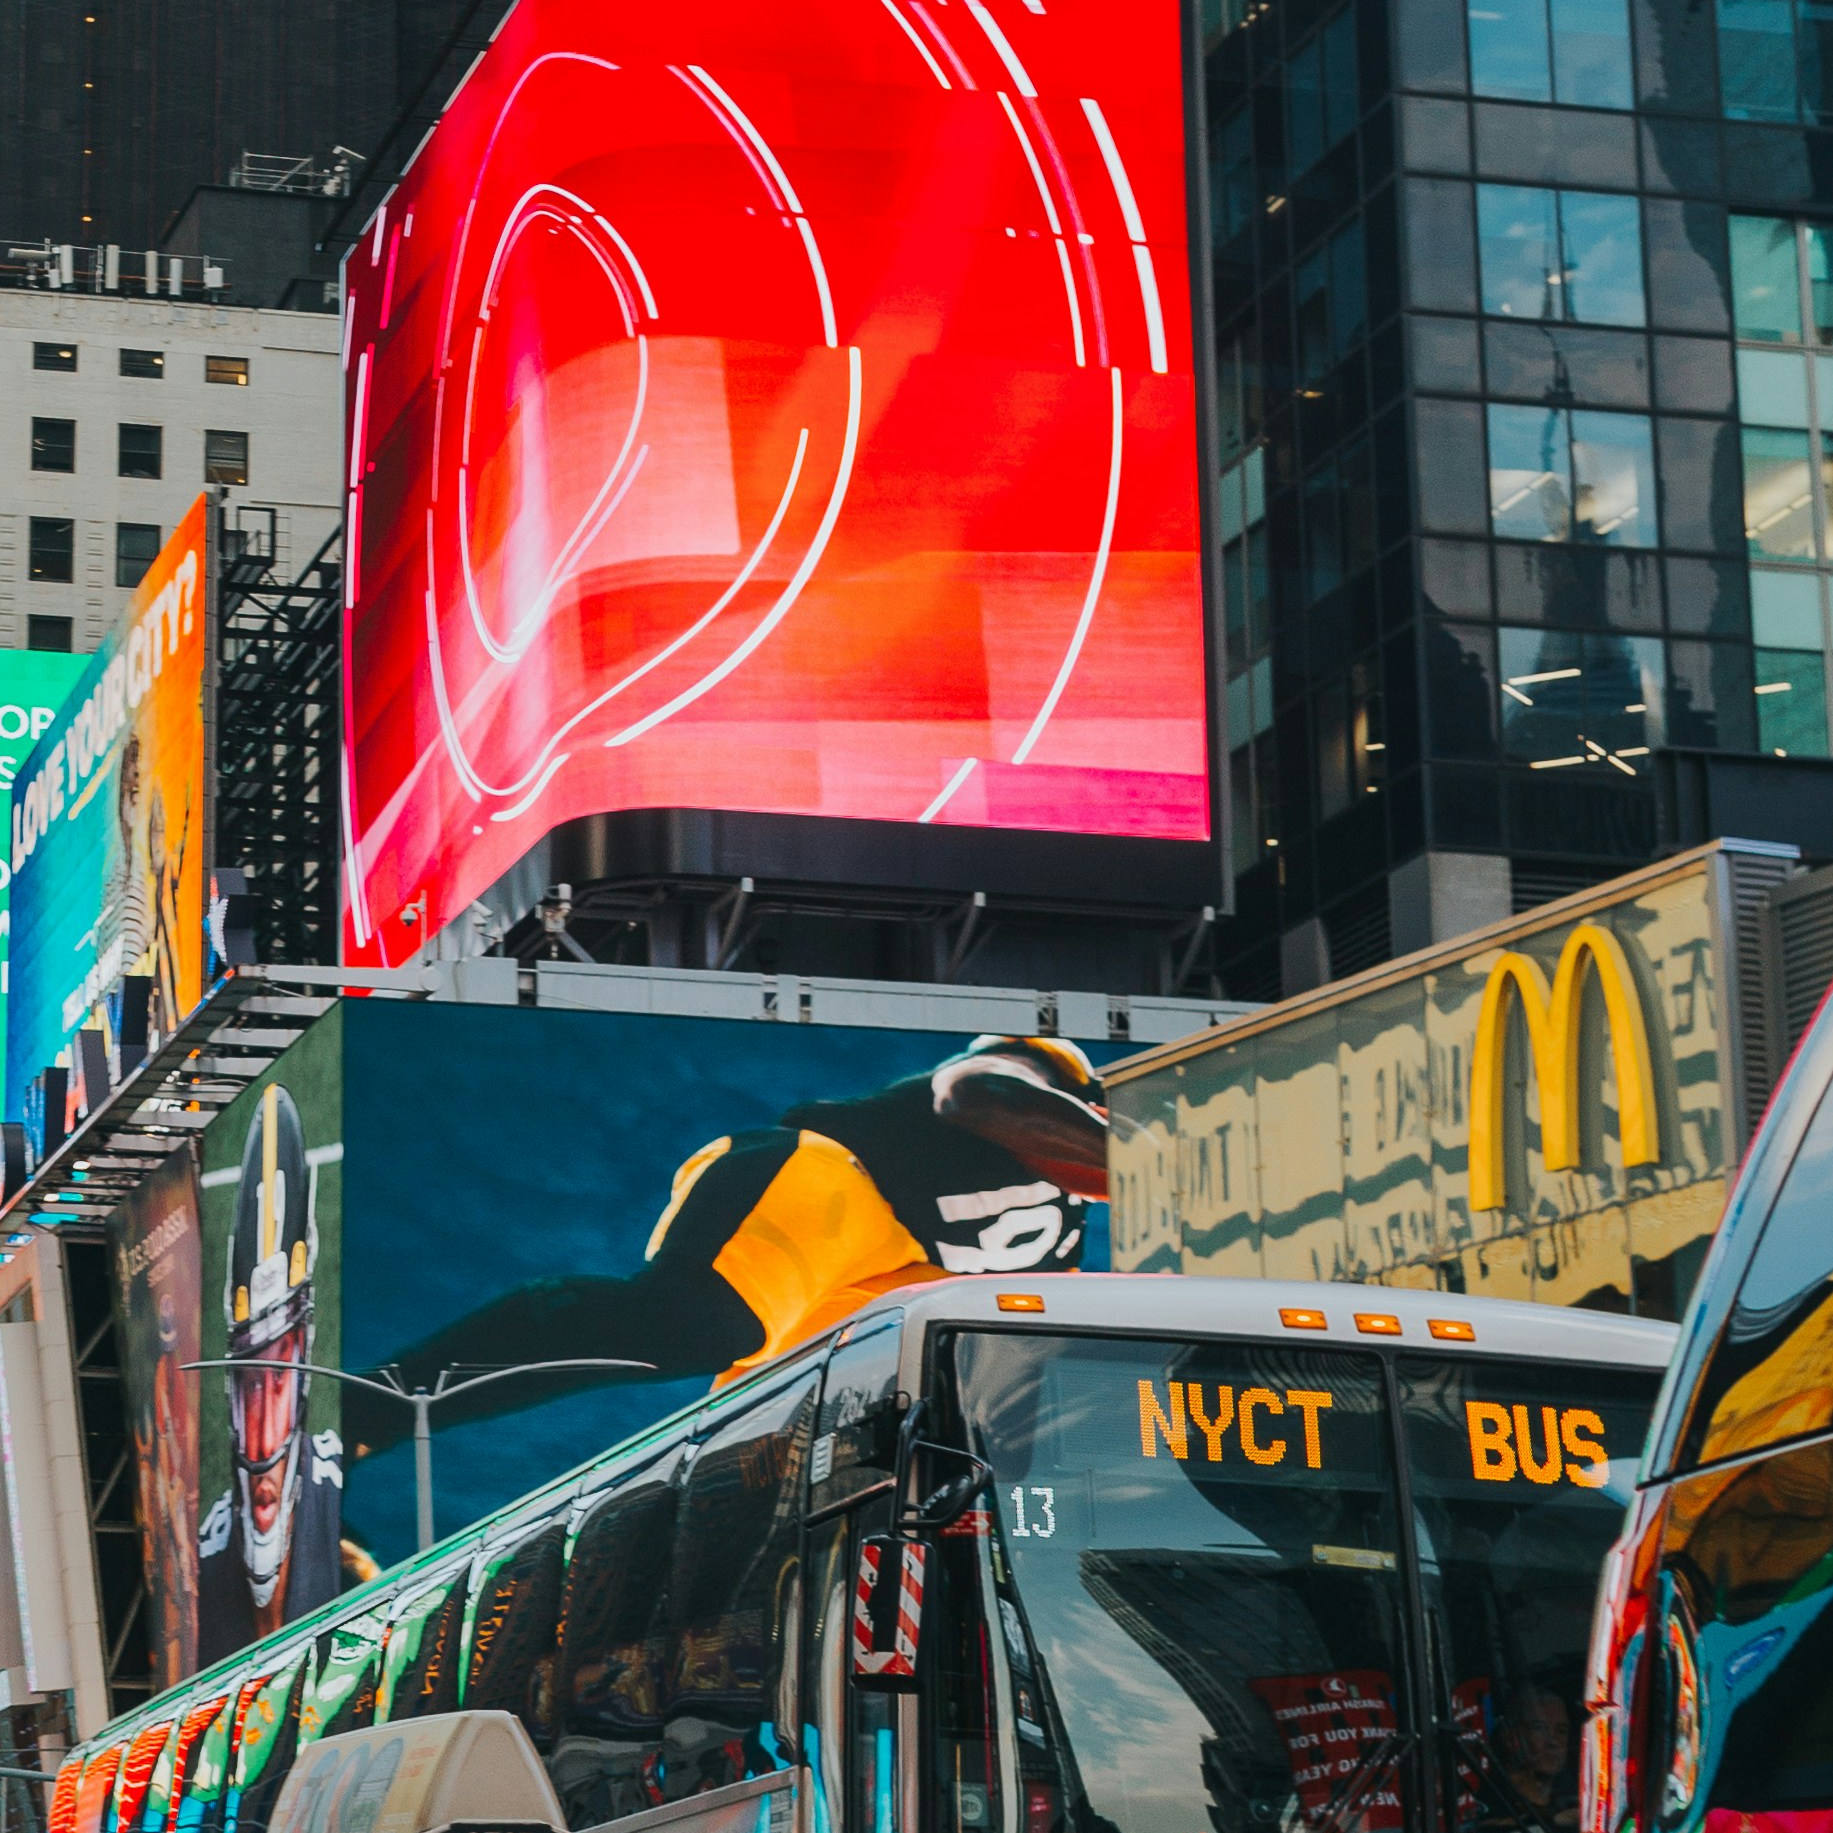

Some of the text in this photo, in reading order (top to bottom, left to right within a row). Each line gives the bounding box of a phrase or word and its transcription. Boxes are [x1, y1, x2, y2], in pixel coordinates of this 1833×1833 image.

[12, 739, 65, 875] LOVE
[1138, 1378, 1611, 1490] NYCT BUS
[1010, 1485, 1057, 1539] 13
